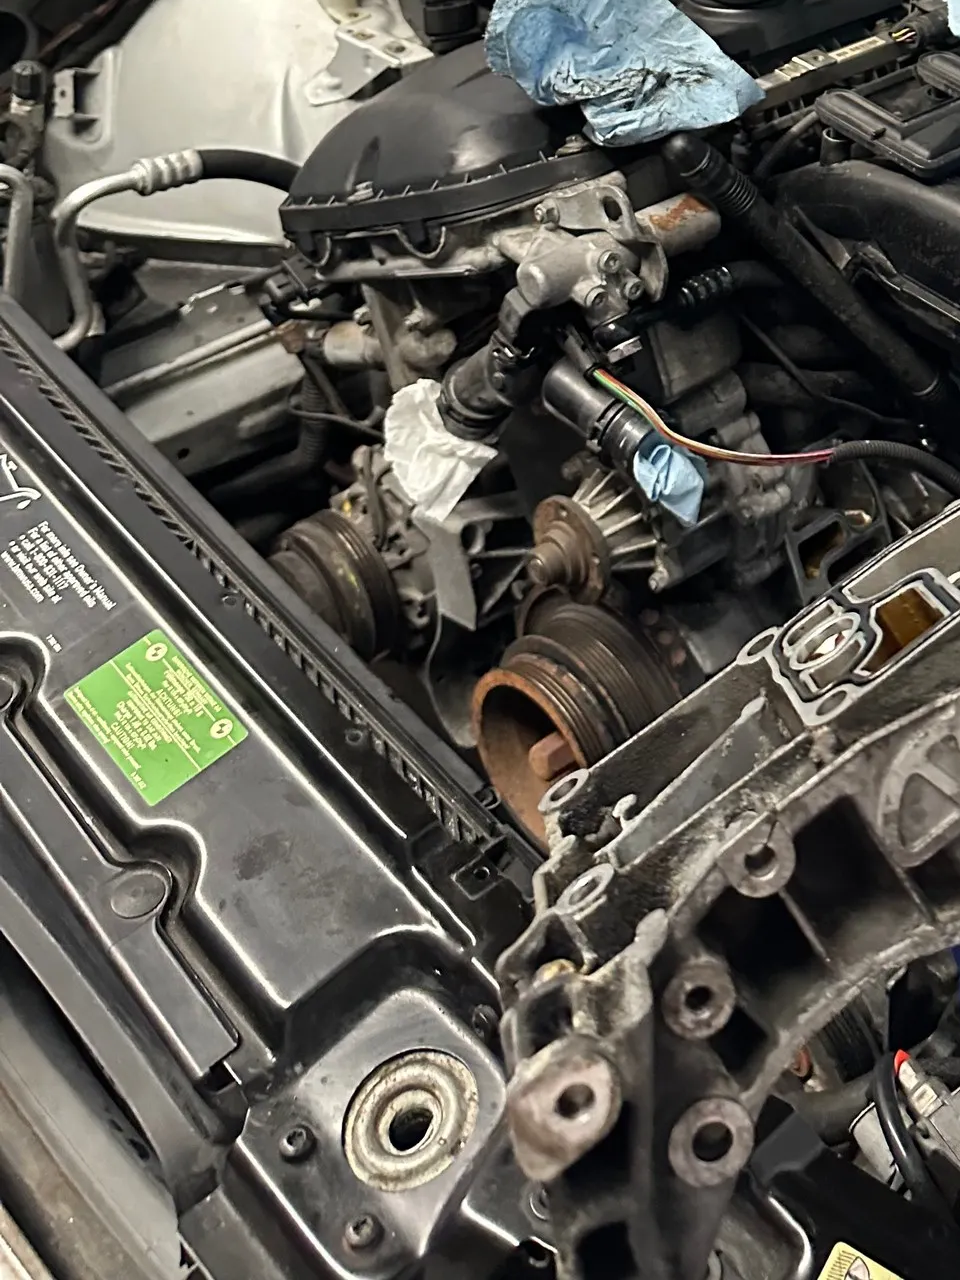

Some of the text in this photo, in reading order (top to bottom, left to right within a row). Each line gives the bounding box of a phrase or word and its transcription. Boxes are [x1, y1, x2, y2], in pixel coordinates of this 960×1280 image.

[28, 526, 42, 540] For
[20, 539, 36, 552] call
[39, 540, 53, 553] list
[46, 546, 59, 558] of
[38, 520, 117, 611] For more info see Owner's Manual
[51, 556, 68, 573] other
[1, 551, 44, 603] www.bmwusa.com
[10, 545, 63, 605] or visit our web site at
[59, 568, 91, 598] approved
[83, 595, 97, 608] oils
[111, 721, 136, 750] CAUTION!
